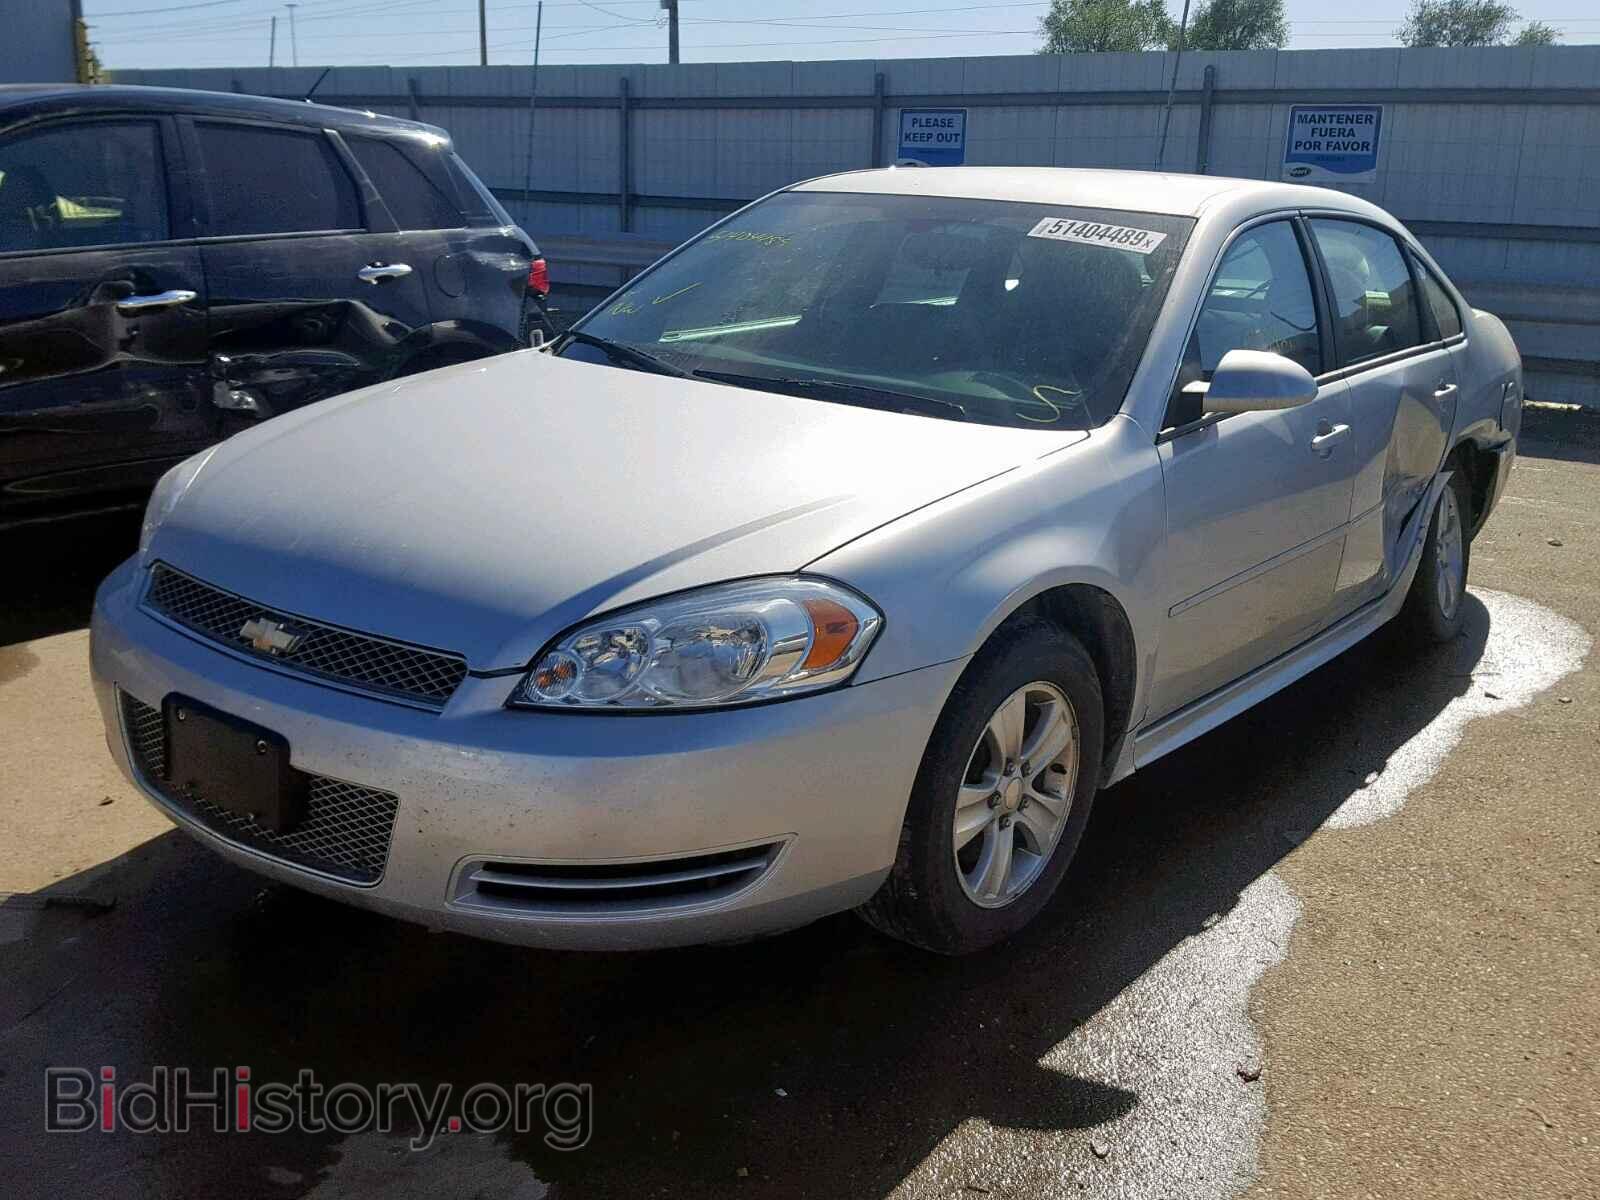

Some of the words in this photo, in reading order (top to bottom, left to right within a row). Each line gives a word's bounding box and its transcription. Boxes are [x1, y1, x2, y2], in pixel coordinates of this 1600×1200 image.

[912, 117, 955, 129] PLEASE
[1297, 113, 1374, 125] MANTENER
[904, 132, 933, 143] KEEP
[936, 132, 961, 143] OUT
[1311, 127, 1356, 138] FUERA
[1294, 140, 1321, 151] POR
[1326, 140, 1370, 152] FAVOR
